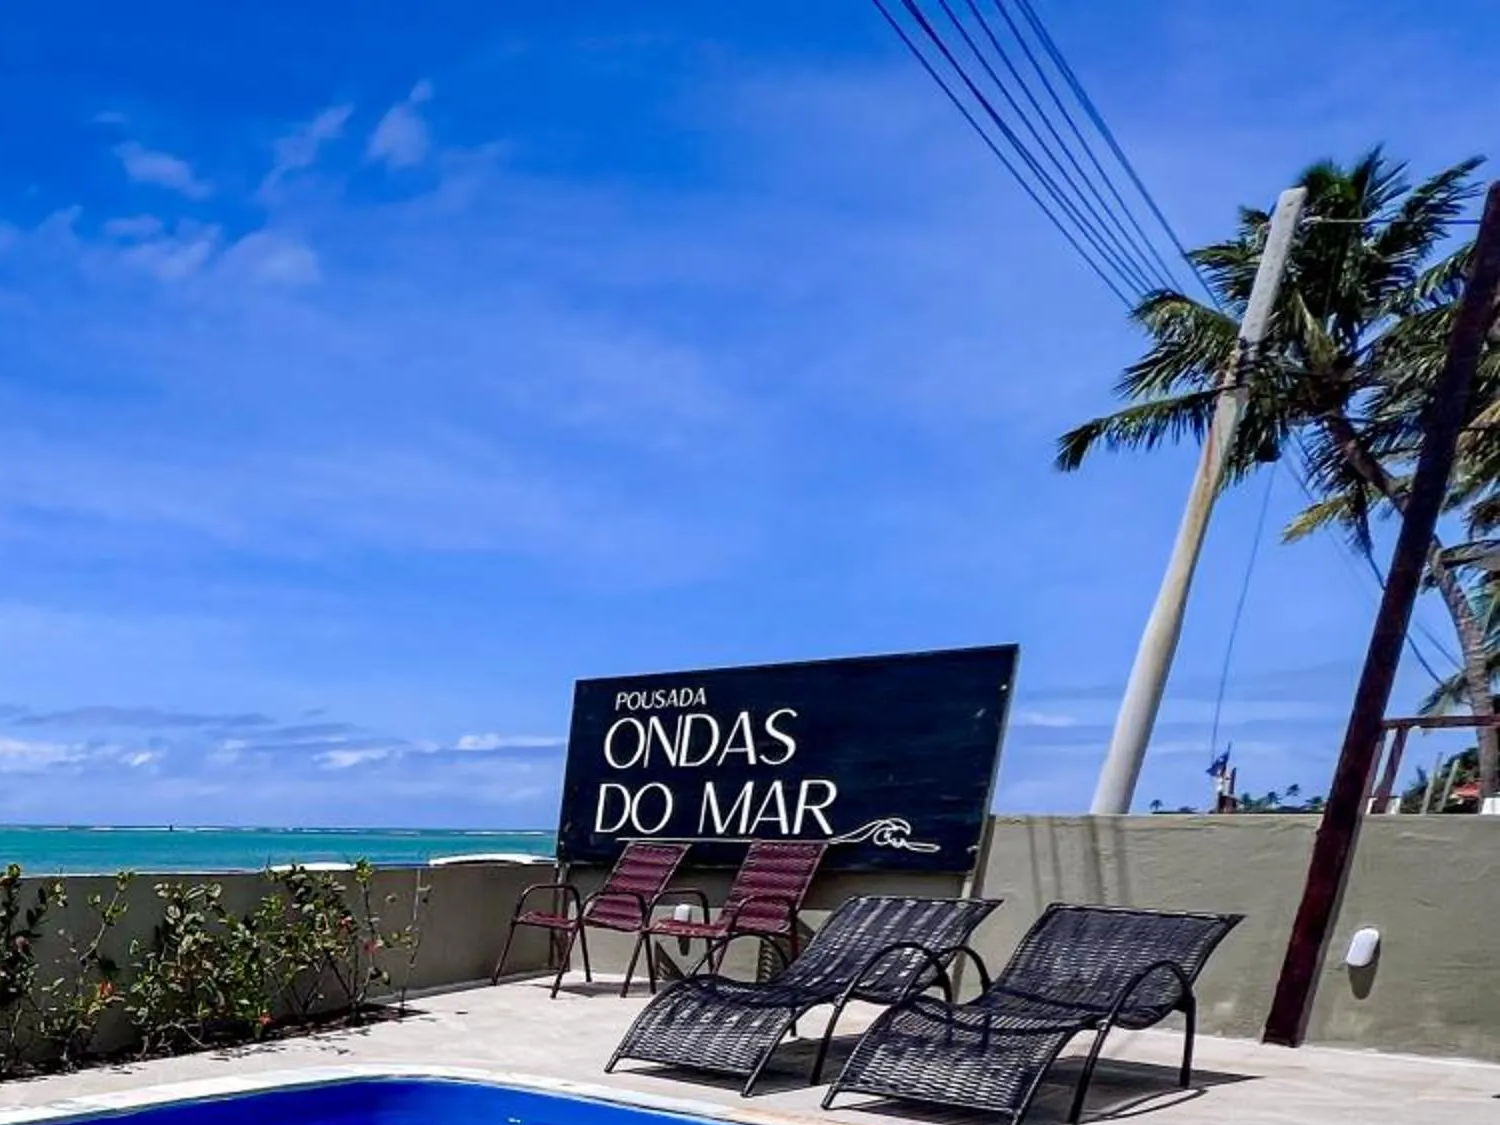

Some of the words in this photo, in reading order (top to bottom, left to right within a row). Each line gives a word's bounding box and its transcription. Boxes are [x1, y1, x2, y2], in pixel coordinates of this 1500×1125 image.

[614, 687, 707, 711] POUSADA
[603, 708, 798, 770] ONDAS
[594, 782, 674, 834] DO
[698, 779, 838, 836] MAR
